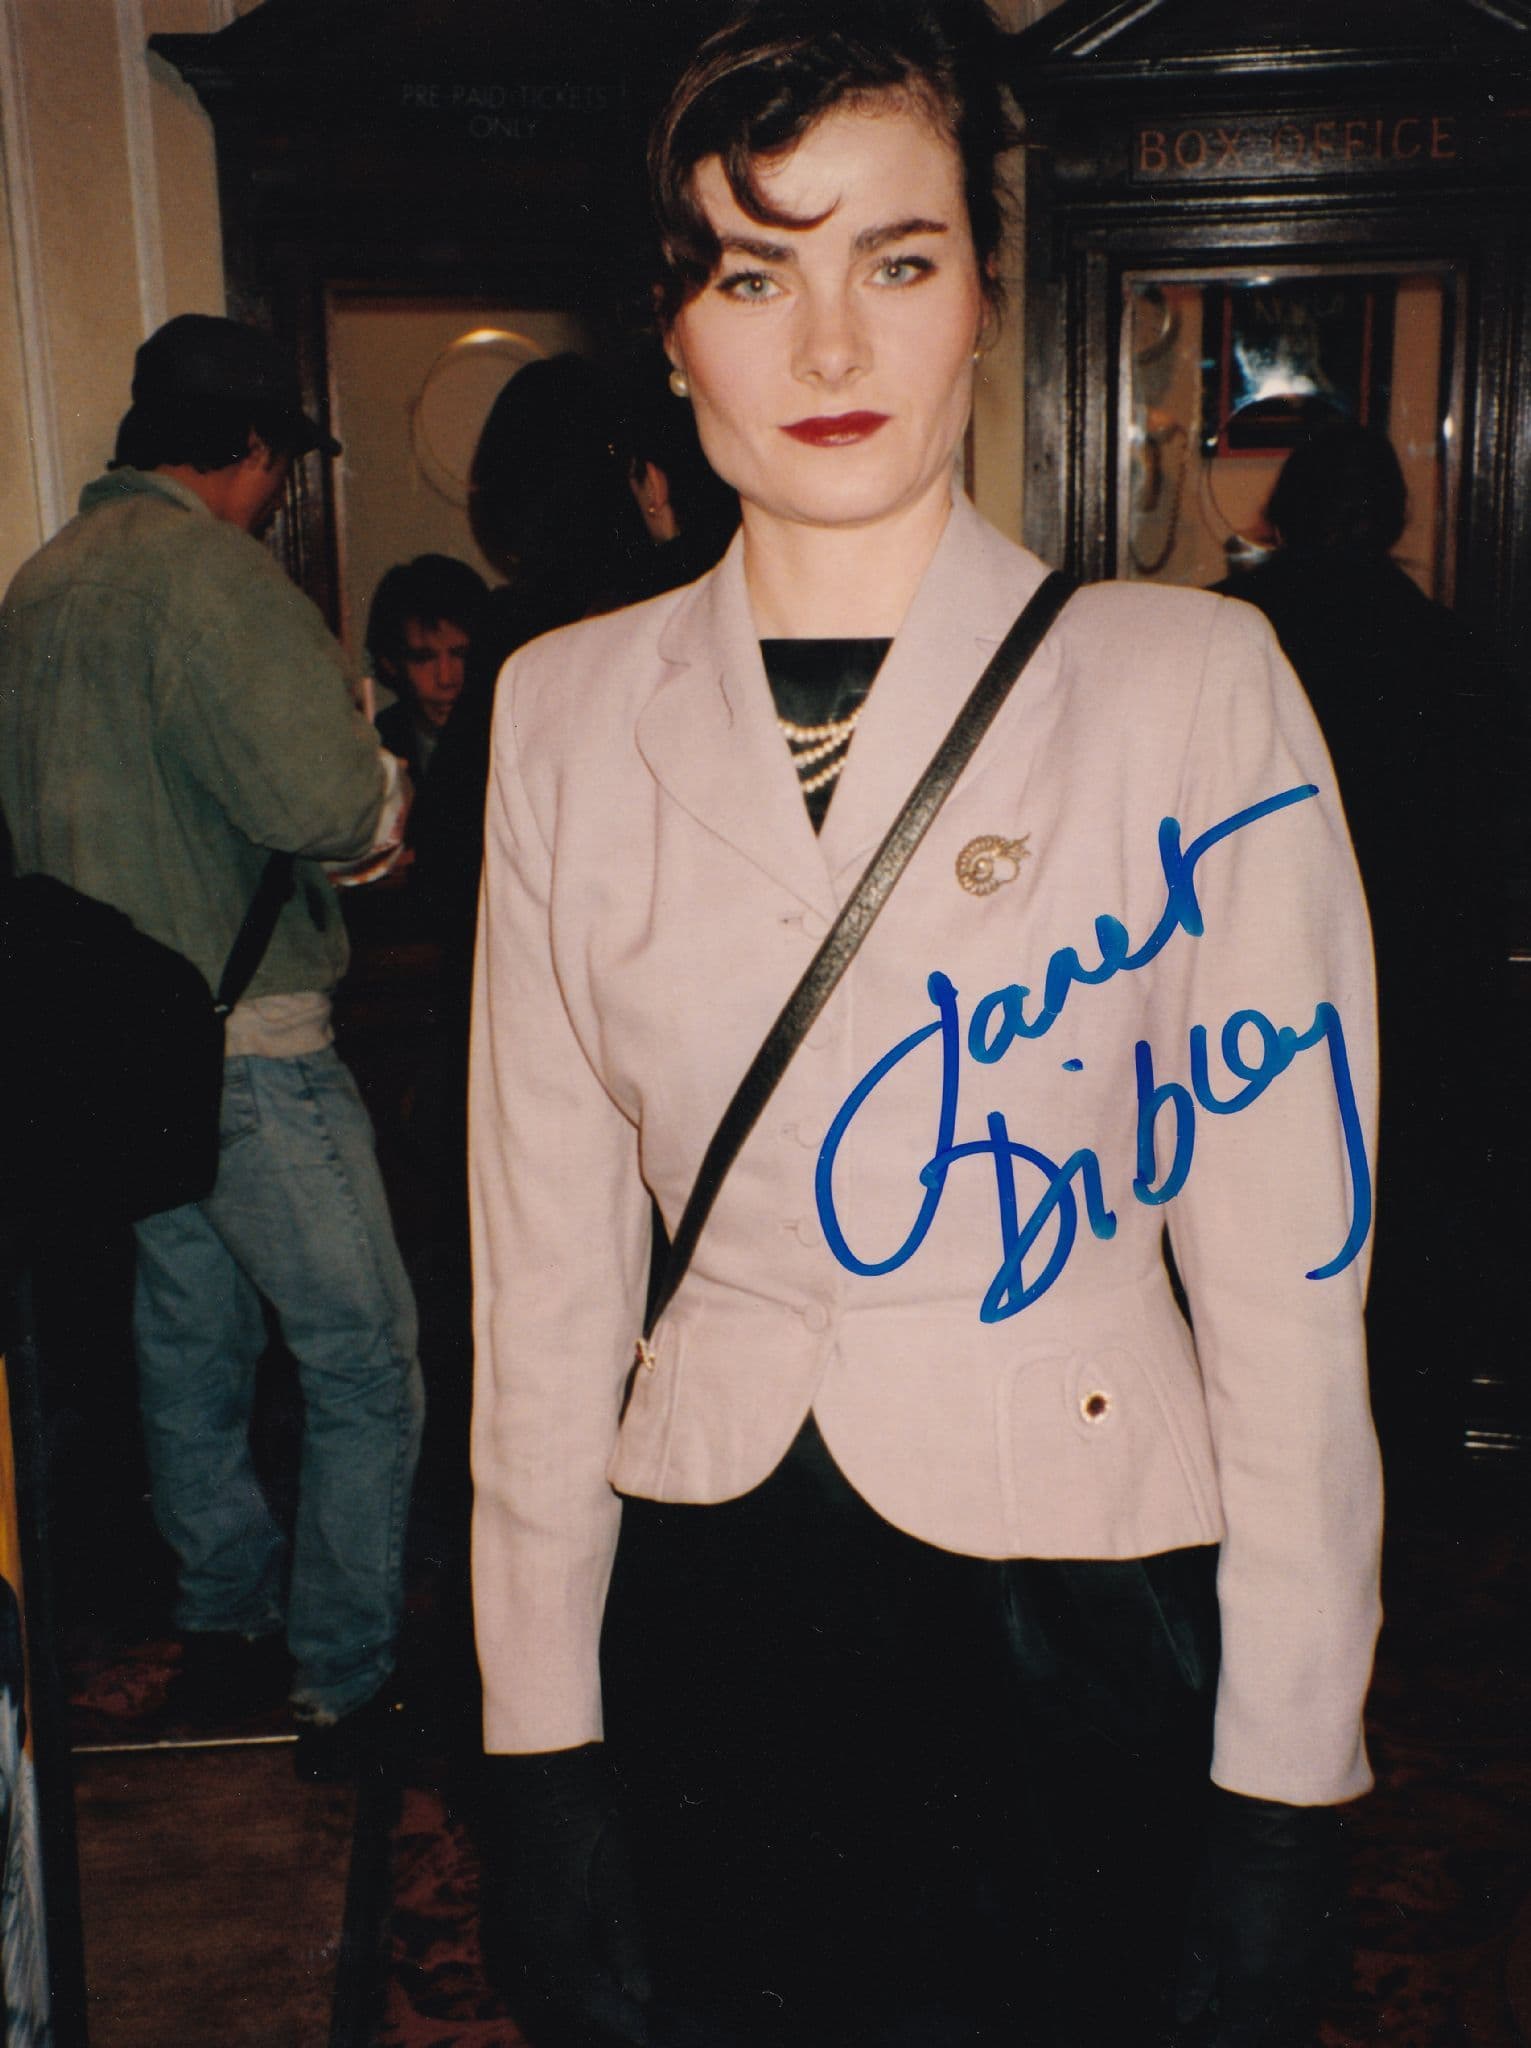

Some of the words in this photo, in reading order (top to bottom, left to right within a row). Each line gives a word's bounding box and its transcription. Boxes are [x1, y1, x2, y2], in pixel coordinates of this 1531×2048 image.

[401, 84, 440, 109] PRE
[453, 84, 505, 109] PAID
[470, 114, 537, 138] ONLY
[1138, 127, 1243, 171] BOX
[1273, 117, 1458, 167] OFFICE
[815, 784, 1319, 1276] Janet
